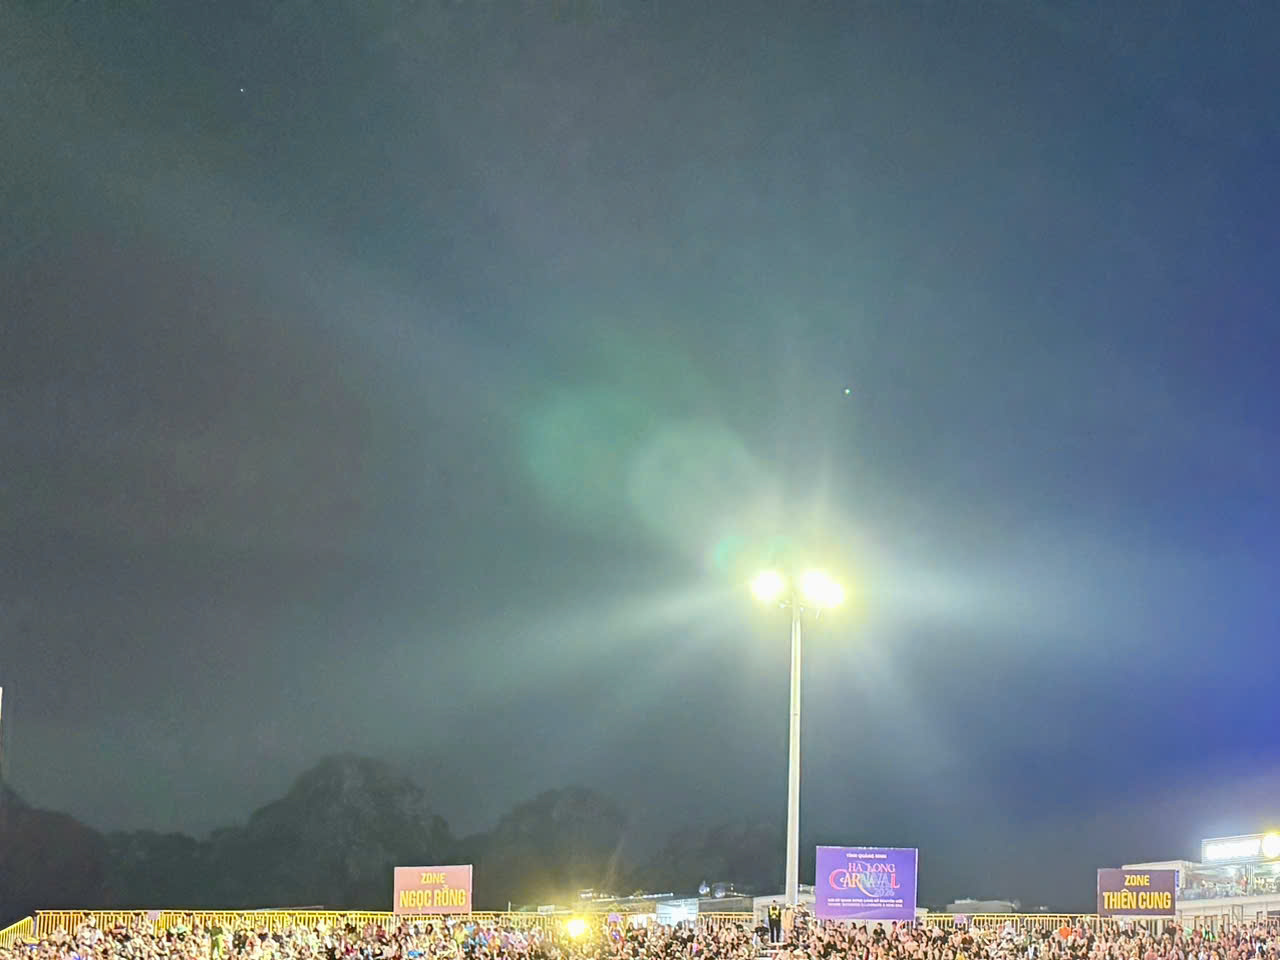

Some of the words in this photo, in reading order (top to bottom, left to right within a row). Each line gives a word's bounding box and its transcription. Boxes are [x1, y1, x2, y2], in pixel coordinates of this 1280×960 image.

[421, 872, 446, 884] ZONE
[1124, 874, 1150, 886] ZONE
[400, 889, 432, 911] NGỌC
[1103, 888, 1137, 909] THIÊN
[1138, 891, 1172, 909] CUNG
